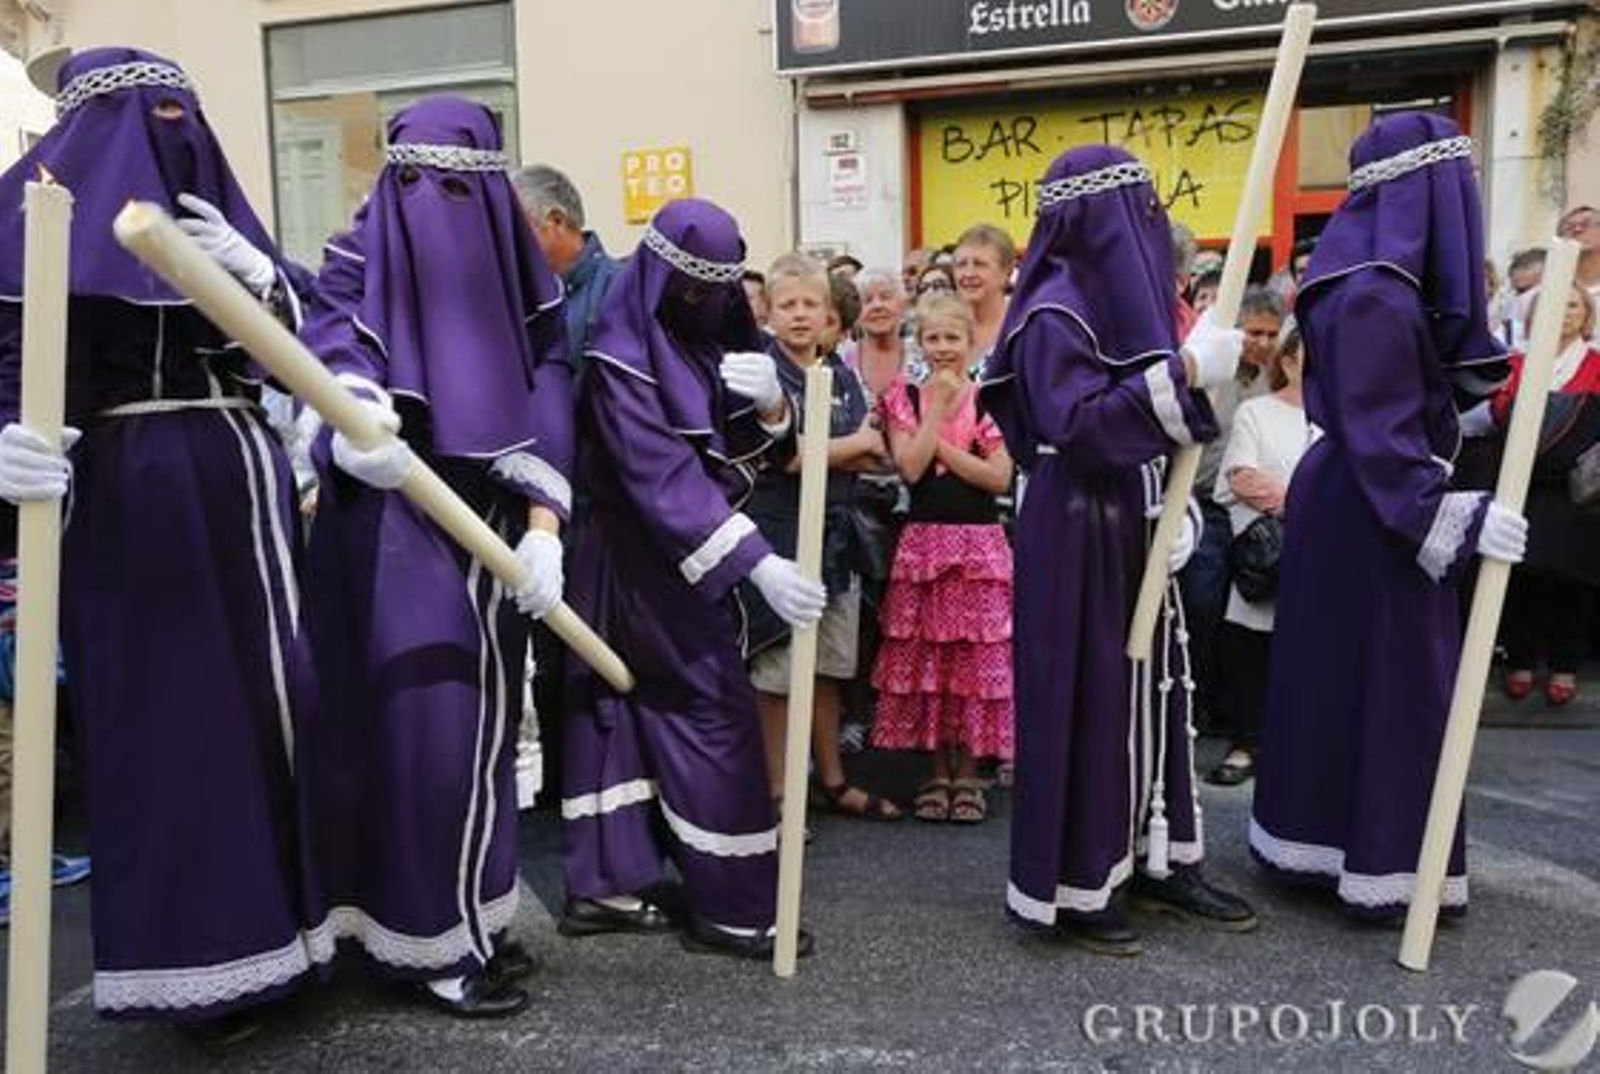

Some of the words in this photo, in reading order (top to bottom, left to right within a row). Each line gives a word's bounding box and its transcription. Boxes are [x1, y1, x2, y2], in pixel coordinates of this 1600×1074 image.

[969, 0, 1091, 34] Estrella
[942, 115, 1041, 162] BAR
[1078, 100, 1253, 147] TAPAS
